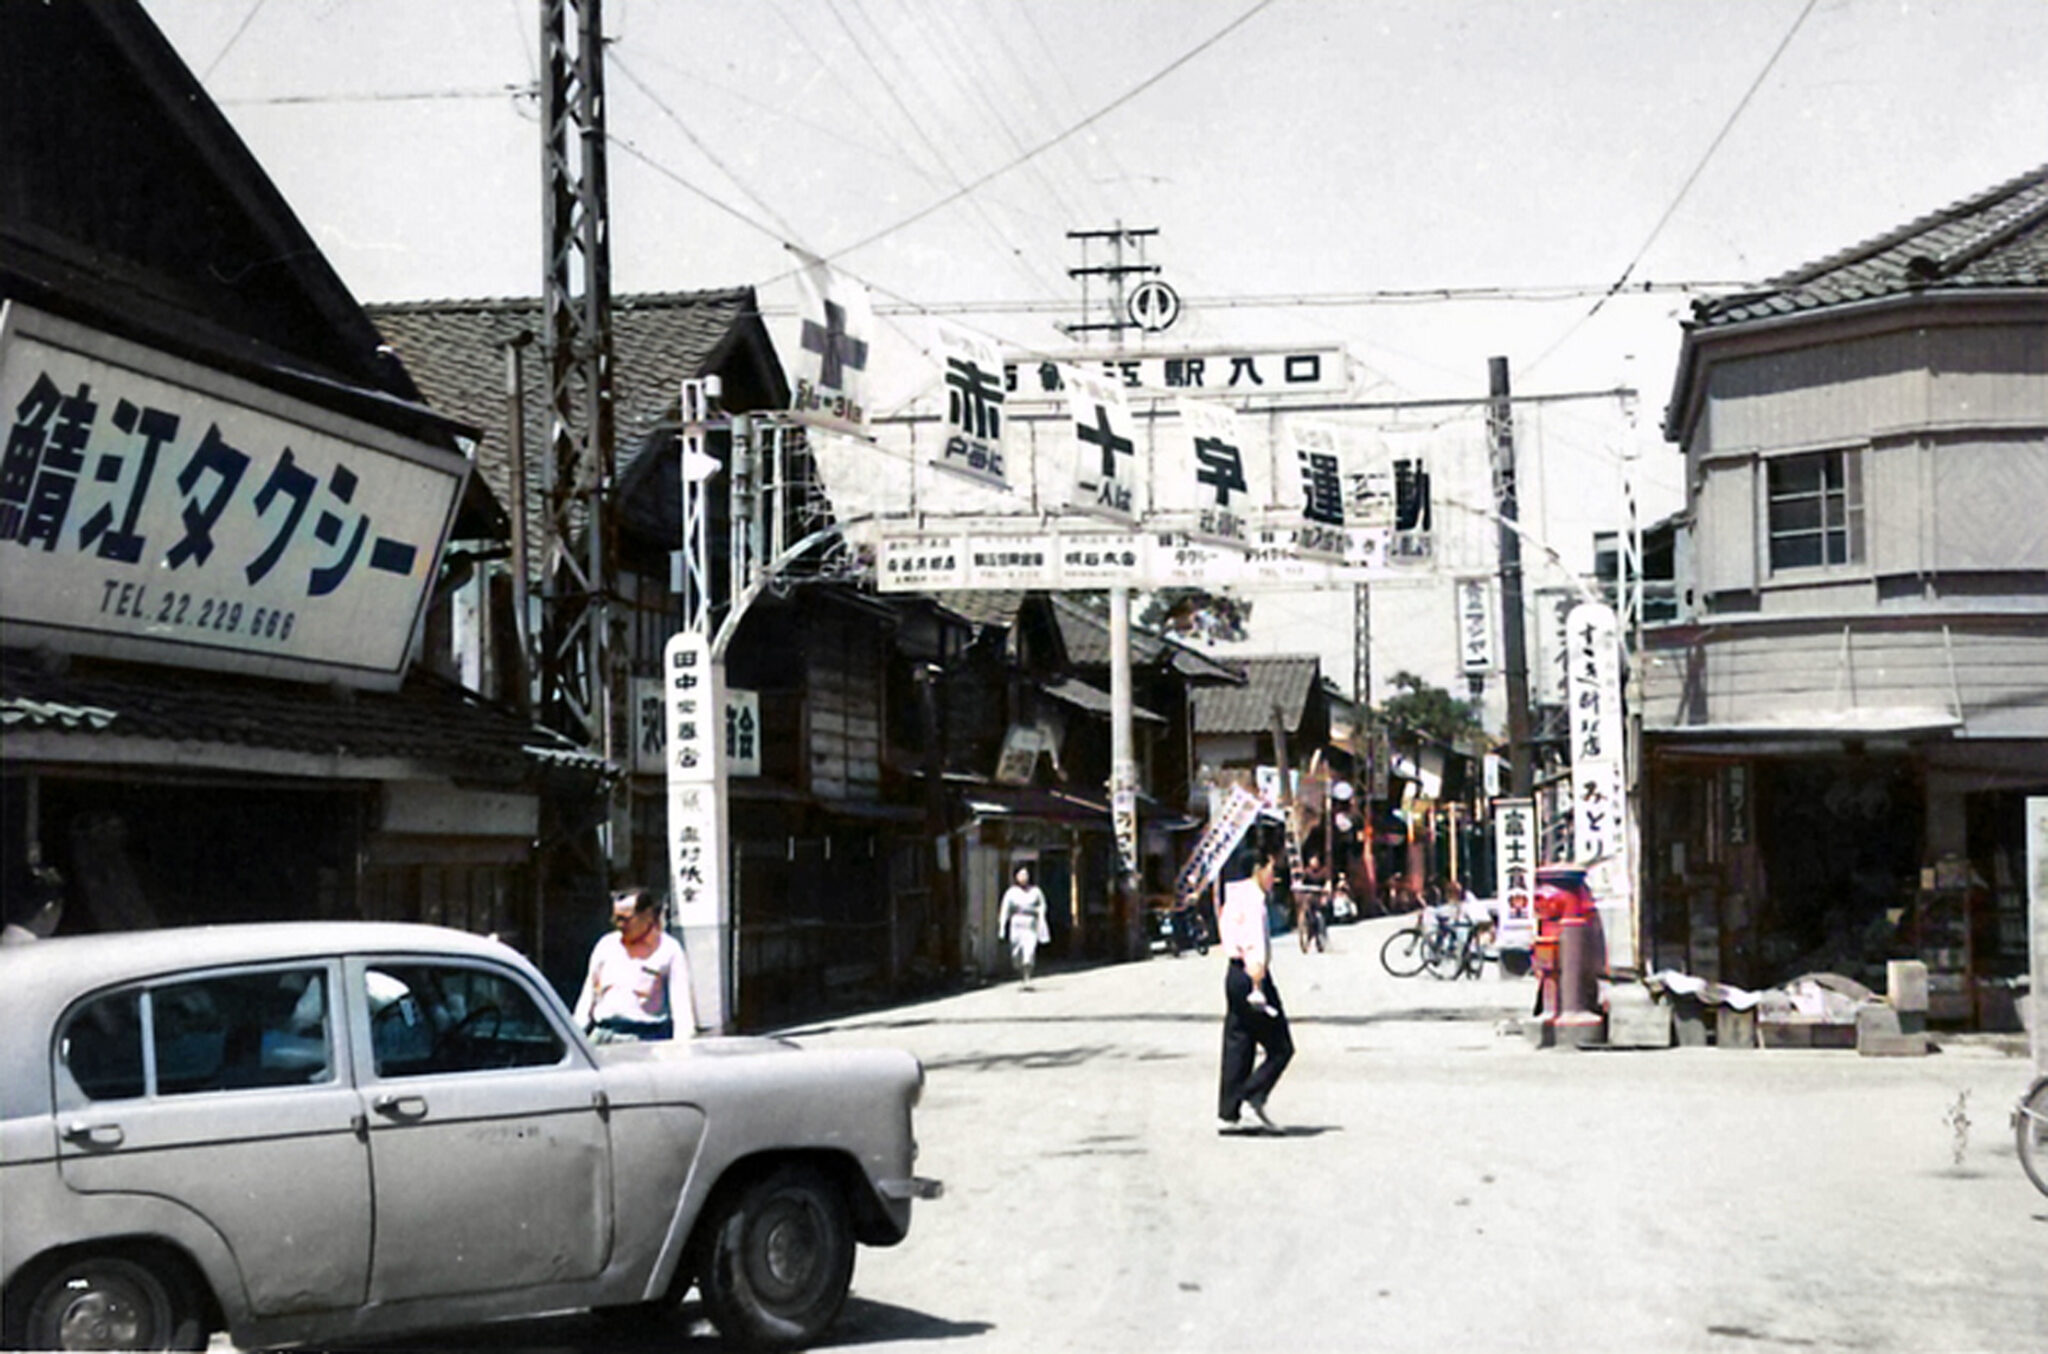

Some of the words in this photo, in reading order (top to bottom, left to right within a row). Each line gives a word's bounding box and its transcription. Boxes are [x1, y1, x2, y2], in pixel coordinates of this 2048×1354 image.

[0, 371, 418, 597] 鯖江タクシー
[945, 356, 1005, 440] 赤
[1077, 404, 1134, 478] 十
[1193, 436, 1248, 507] 字
[1297, 450, 1345, 526] 運
[1392, 458, 1431, 531] 動
[1078, 481, 1132, 513] 一人は
[1503, 808, 1529, 920] 富士食堂
[1580, 779, 1607, 862] みどり
